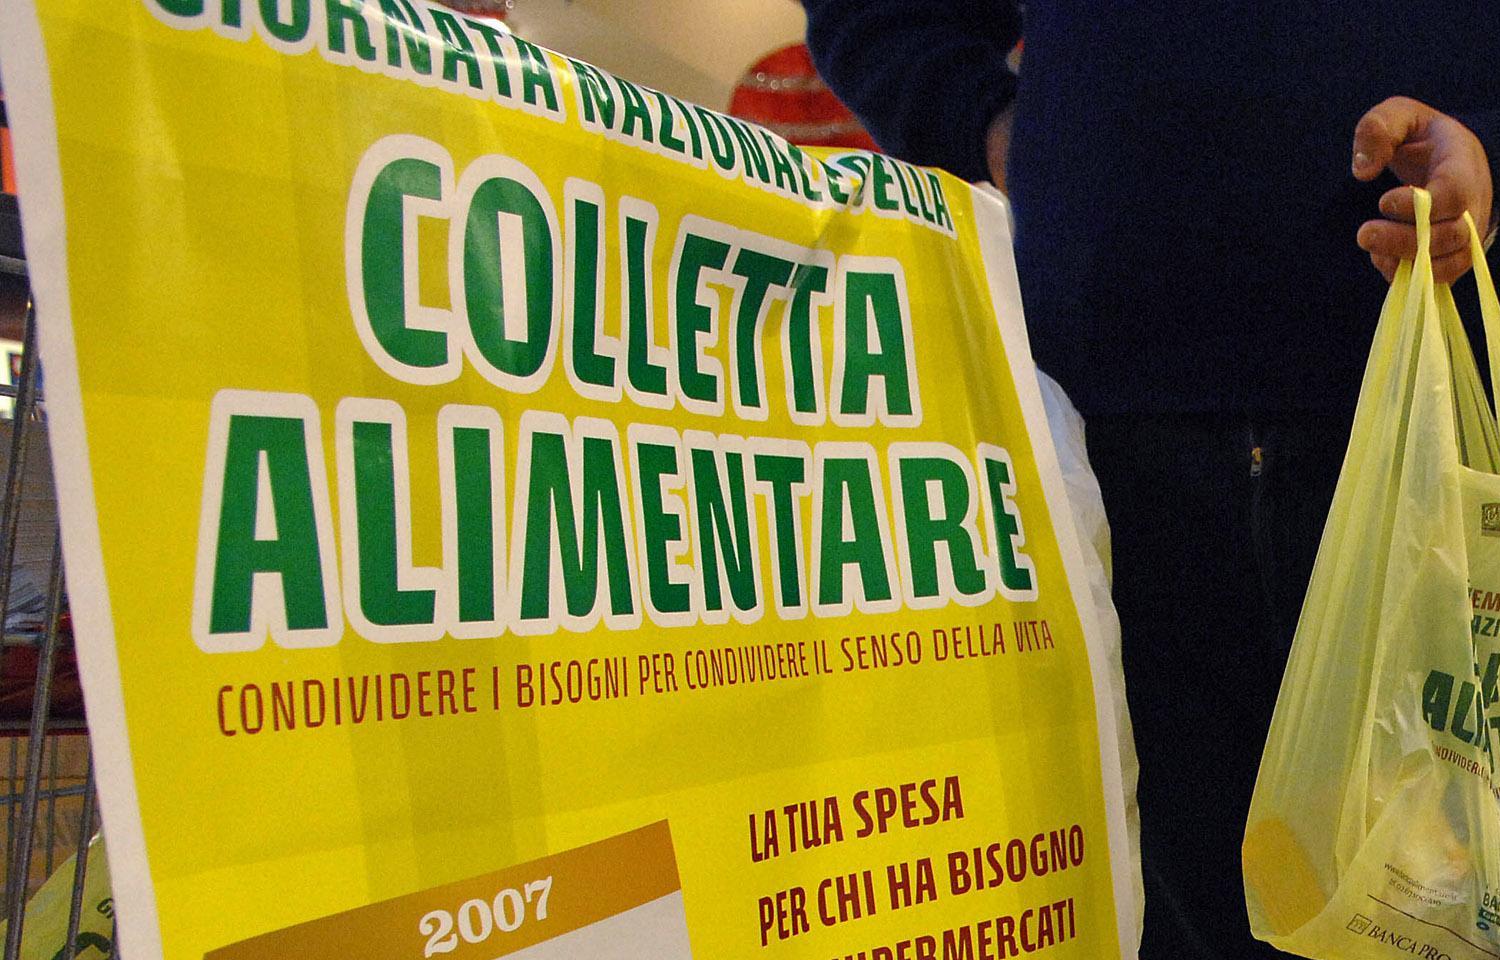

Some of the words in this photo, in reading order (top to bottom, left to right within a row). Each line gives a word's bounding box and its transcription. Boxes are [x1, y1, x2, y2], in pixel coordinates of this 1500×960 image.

[152, 0, 560, 112] ORNATA
[568, 57, 854, 206] NAZIONALE
[361, 158, 912, 416] COLLETTA
[209, 414, 1034, 635] ALIMENTARE
[217, 667, 477, 737] CONDIVIDERE
[492, 666, 500, 710] I
[516, 656, 629, 709] BISOGNI
[638, 652, 679, 696] PER
[684, 640, 809, 690] CONDIVIDERE
[813, 640, 833, 677] IL
[840, 630, 922, 673] SENSO
[933, 622, 1006, 662] DELLA
[1013, 619, 1055, 653] VITA
[748, 808, 779, 864] LA
[784, 795, 845, 854] TUA
[853, 775, 965, 839] SPESA
[418, 875, 554, 959] 2007
[757, 886, 811, 947] PER
[817, 869, 876, 927] CHI
[886, 857, 938, 911] HA
[947, 824, 1085, 896] BISOGNO
[1367, 924, 1417, 955] BANCA
